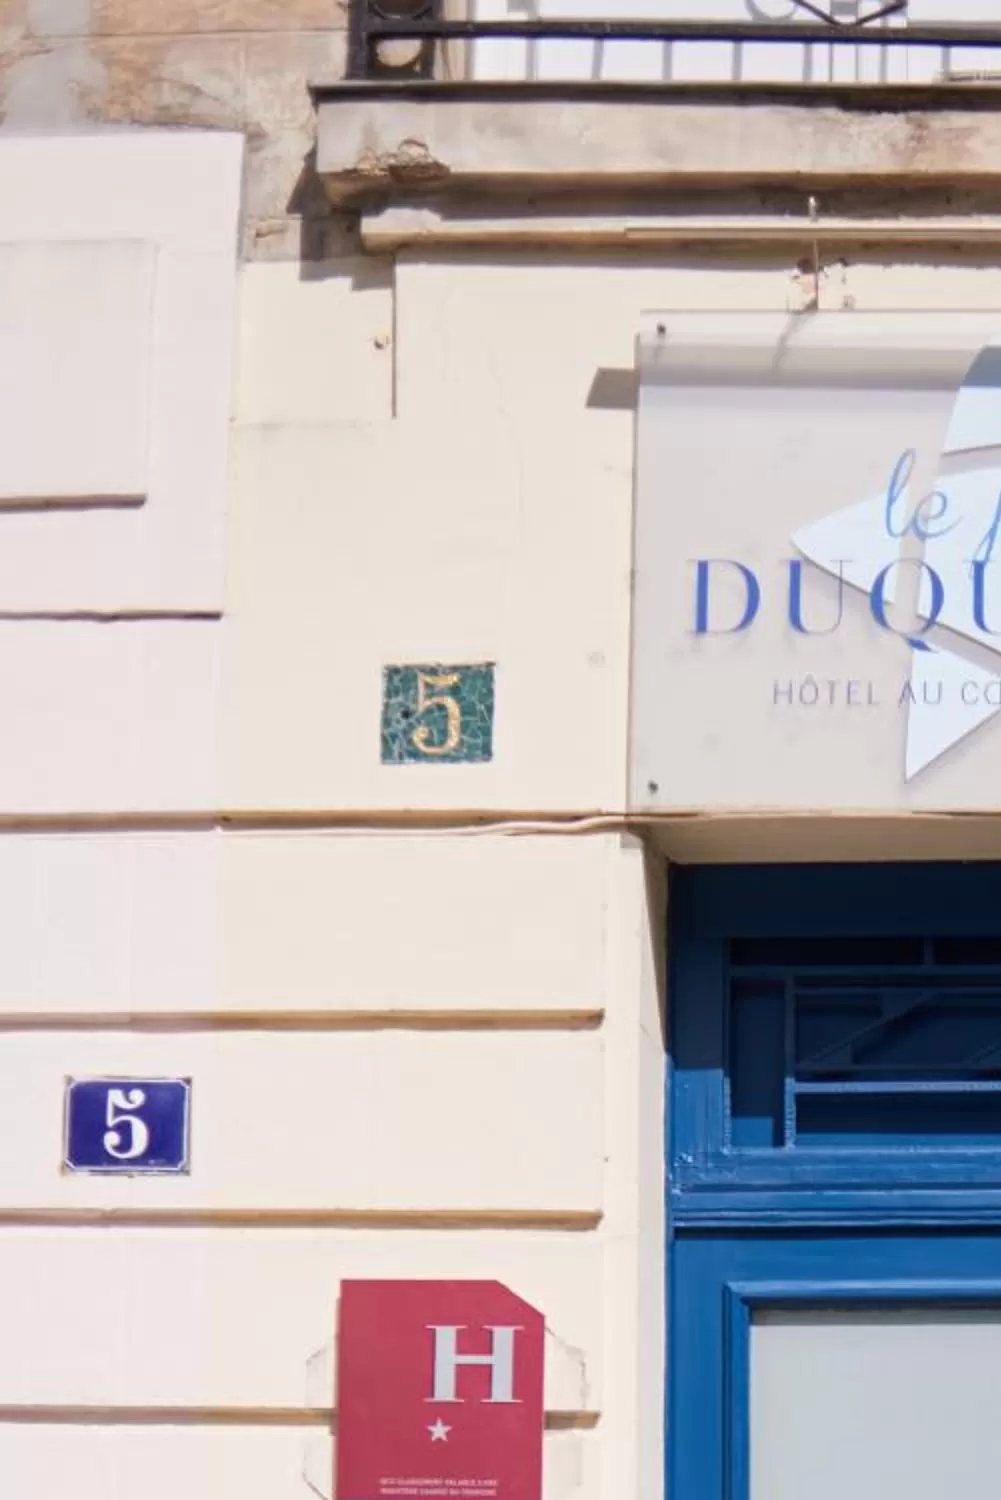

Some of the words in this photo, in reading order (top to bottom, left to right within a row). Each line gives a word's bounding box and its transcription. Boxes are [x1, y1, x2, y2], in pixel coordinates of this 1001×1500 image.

[885, 447, 962, 542] le
[411, 671, 462, 756] 5
[772, 674, 880, 706] HÔTEL
[898, 680, 942, 706] AU
[103, 1088, 149, 1159] 5
[423, 1324, 525, 1404] H
